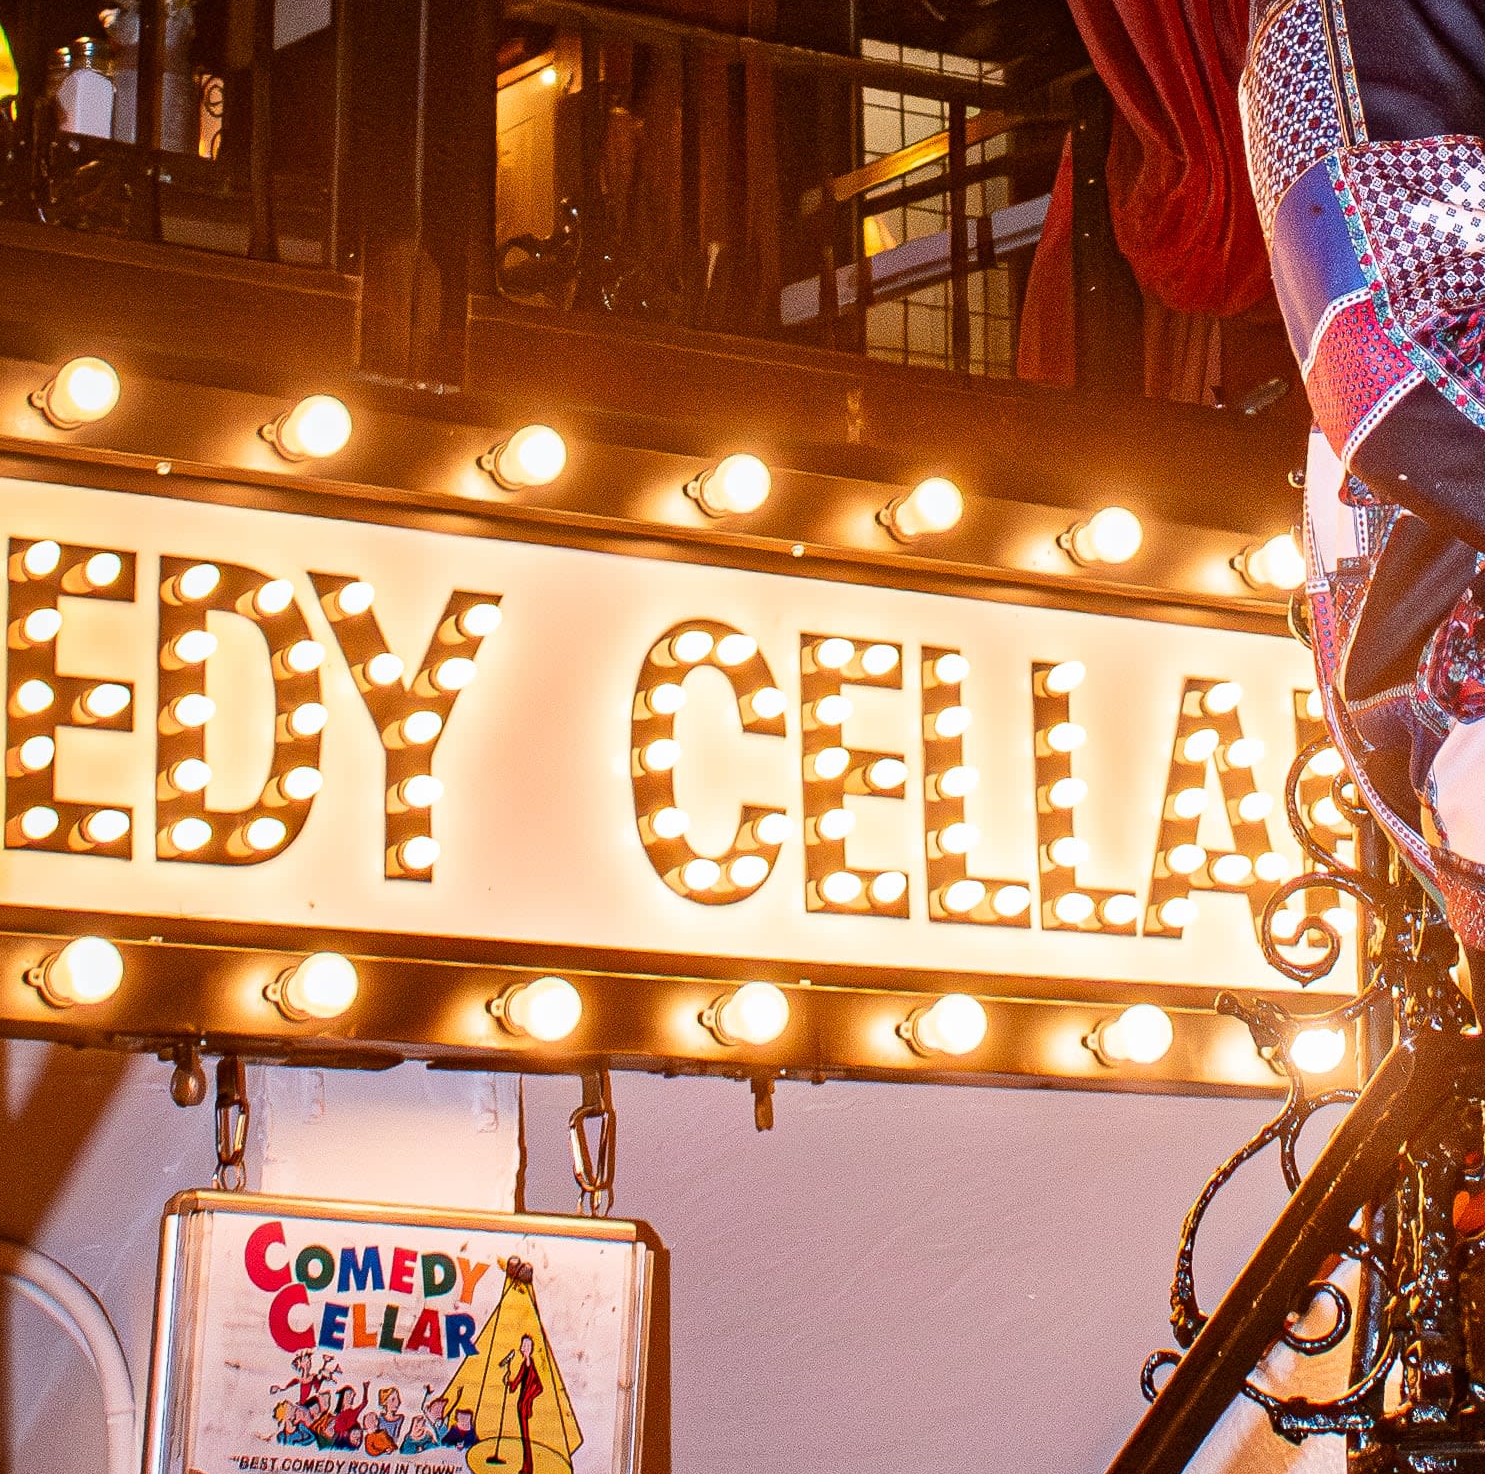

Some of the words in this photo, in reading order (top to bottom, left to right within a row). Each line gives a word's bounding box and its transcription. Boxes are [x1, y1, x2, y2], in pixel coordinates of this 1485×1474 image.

[5, 537, 503, 882] EDY
[244, 1221, 490, 1305] COMEDY
[268, 1283, 479, 1359] CELLAR
[230, 1455, 276, 1471] "BEST
[282, 1458, 346, 1474] COMEDY
